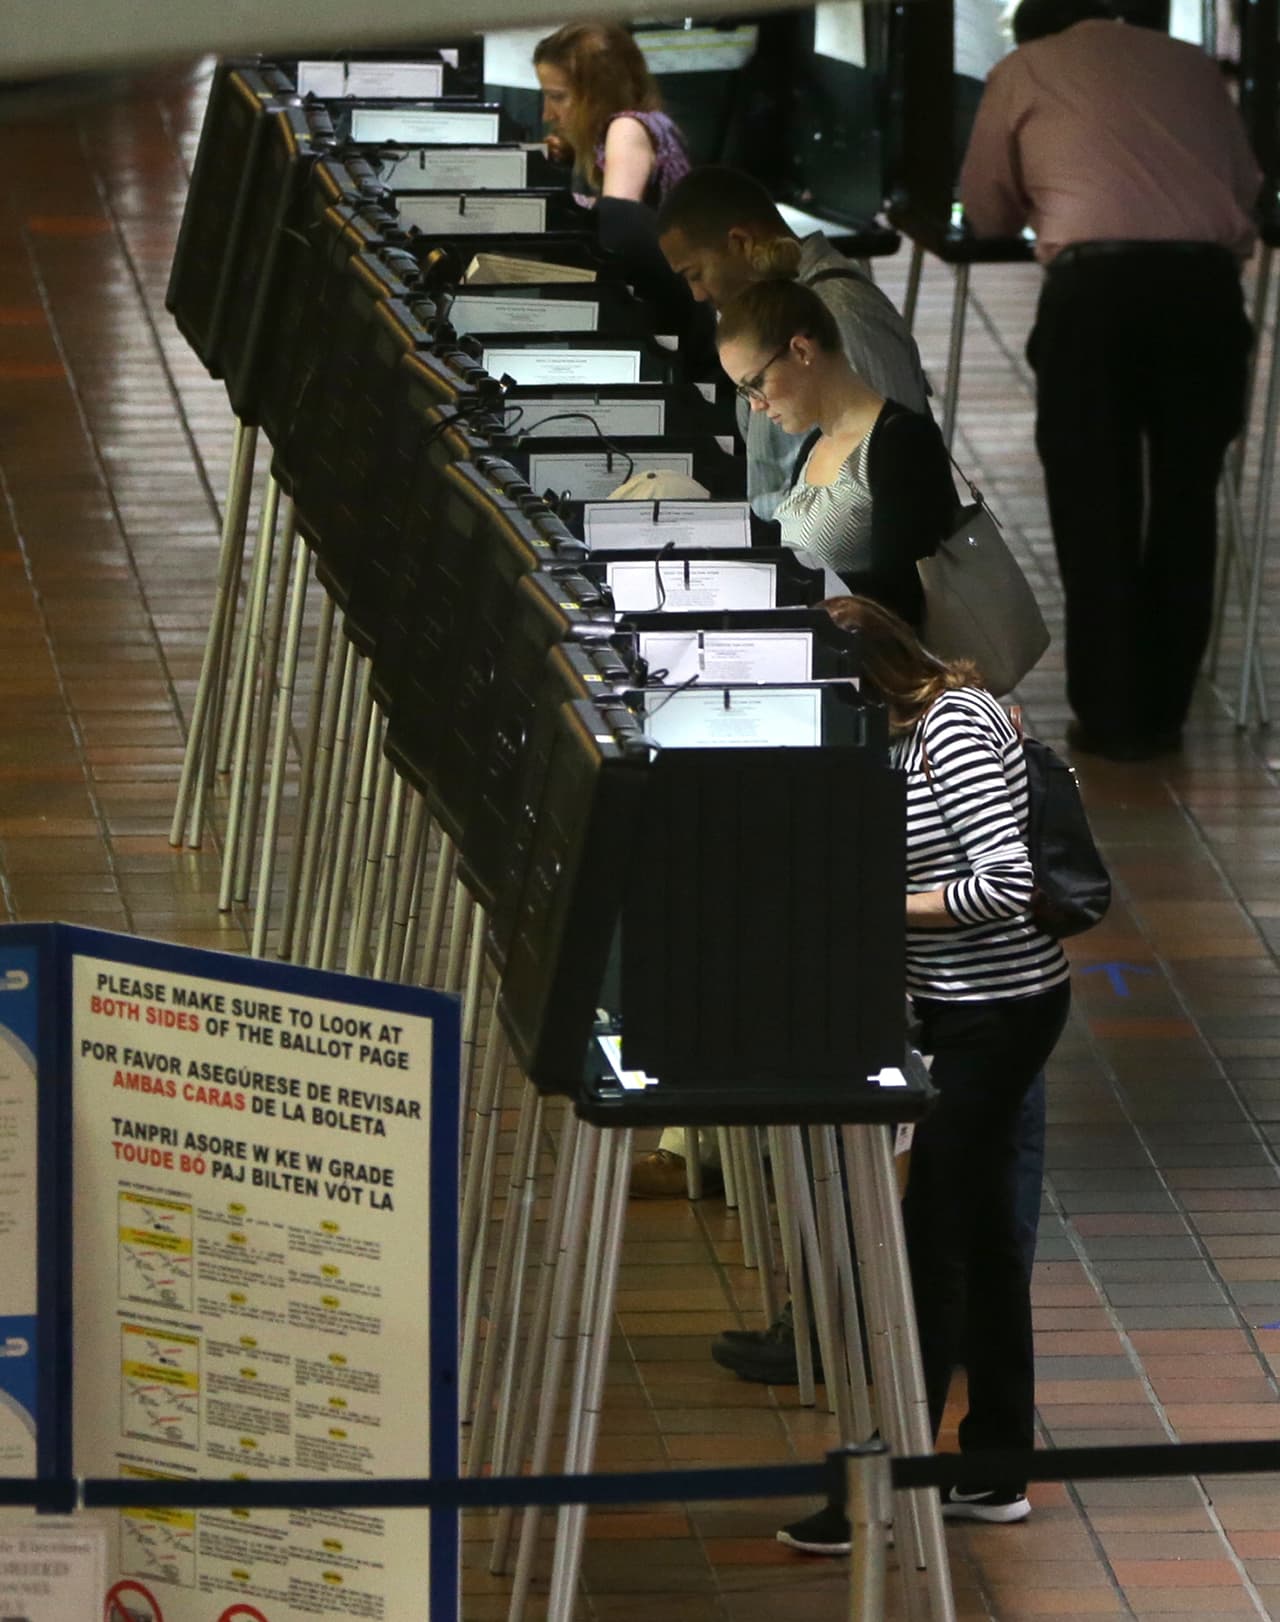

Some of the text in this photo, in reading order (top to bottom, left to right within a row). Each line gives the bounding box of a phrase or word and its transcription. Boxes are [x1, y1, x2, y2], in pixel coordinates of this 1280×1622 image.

[90, 995, 409, 1070] BOTH SIDES OF THE BALLOT PAGE
[97, 973, 403, 1045] PLEASE MAKE SURE TO LOOK AT
[81, 1039, 421, 1119] POR FAVOR ASEGÚRESE DE REVISAR
[113, 1070, 386, 1137] AMBAS CARAS DE LA BOLETA
[111, 1117, 394, 1187] TANPRI ASORE W KE W GRADE
[111, 1141, 174, 1170] TOUDE
[212, 1160, 245, 1183] PAJ
[252, 1168, 318, 1197] BILTEN
[370, 1190, 394, 1211] LA
